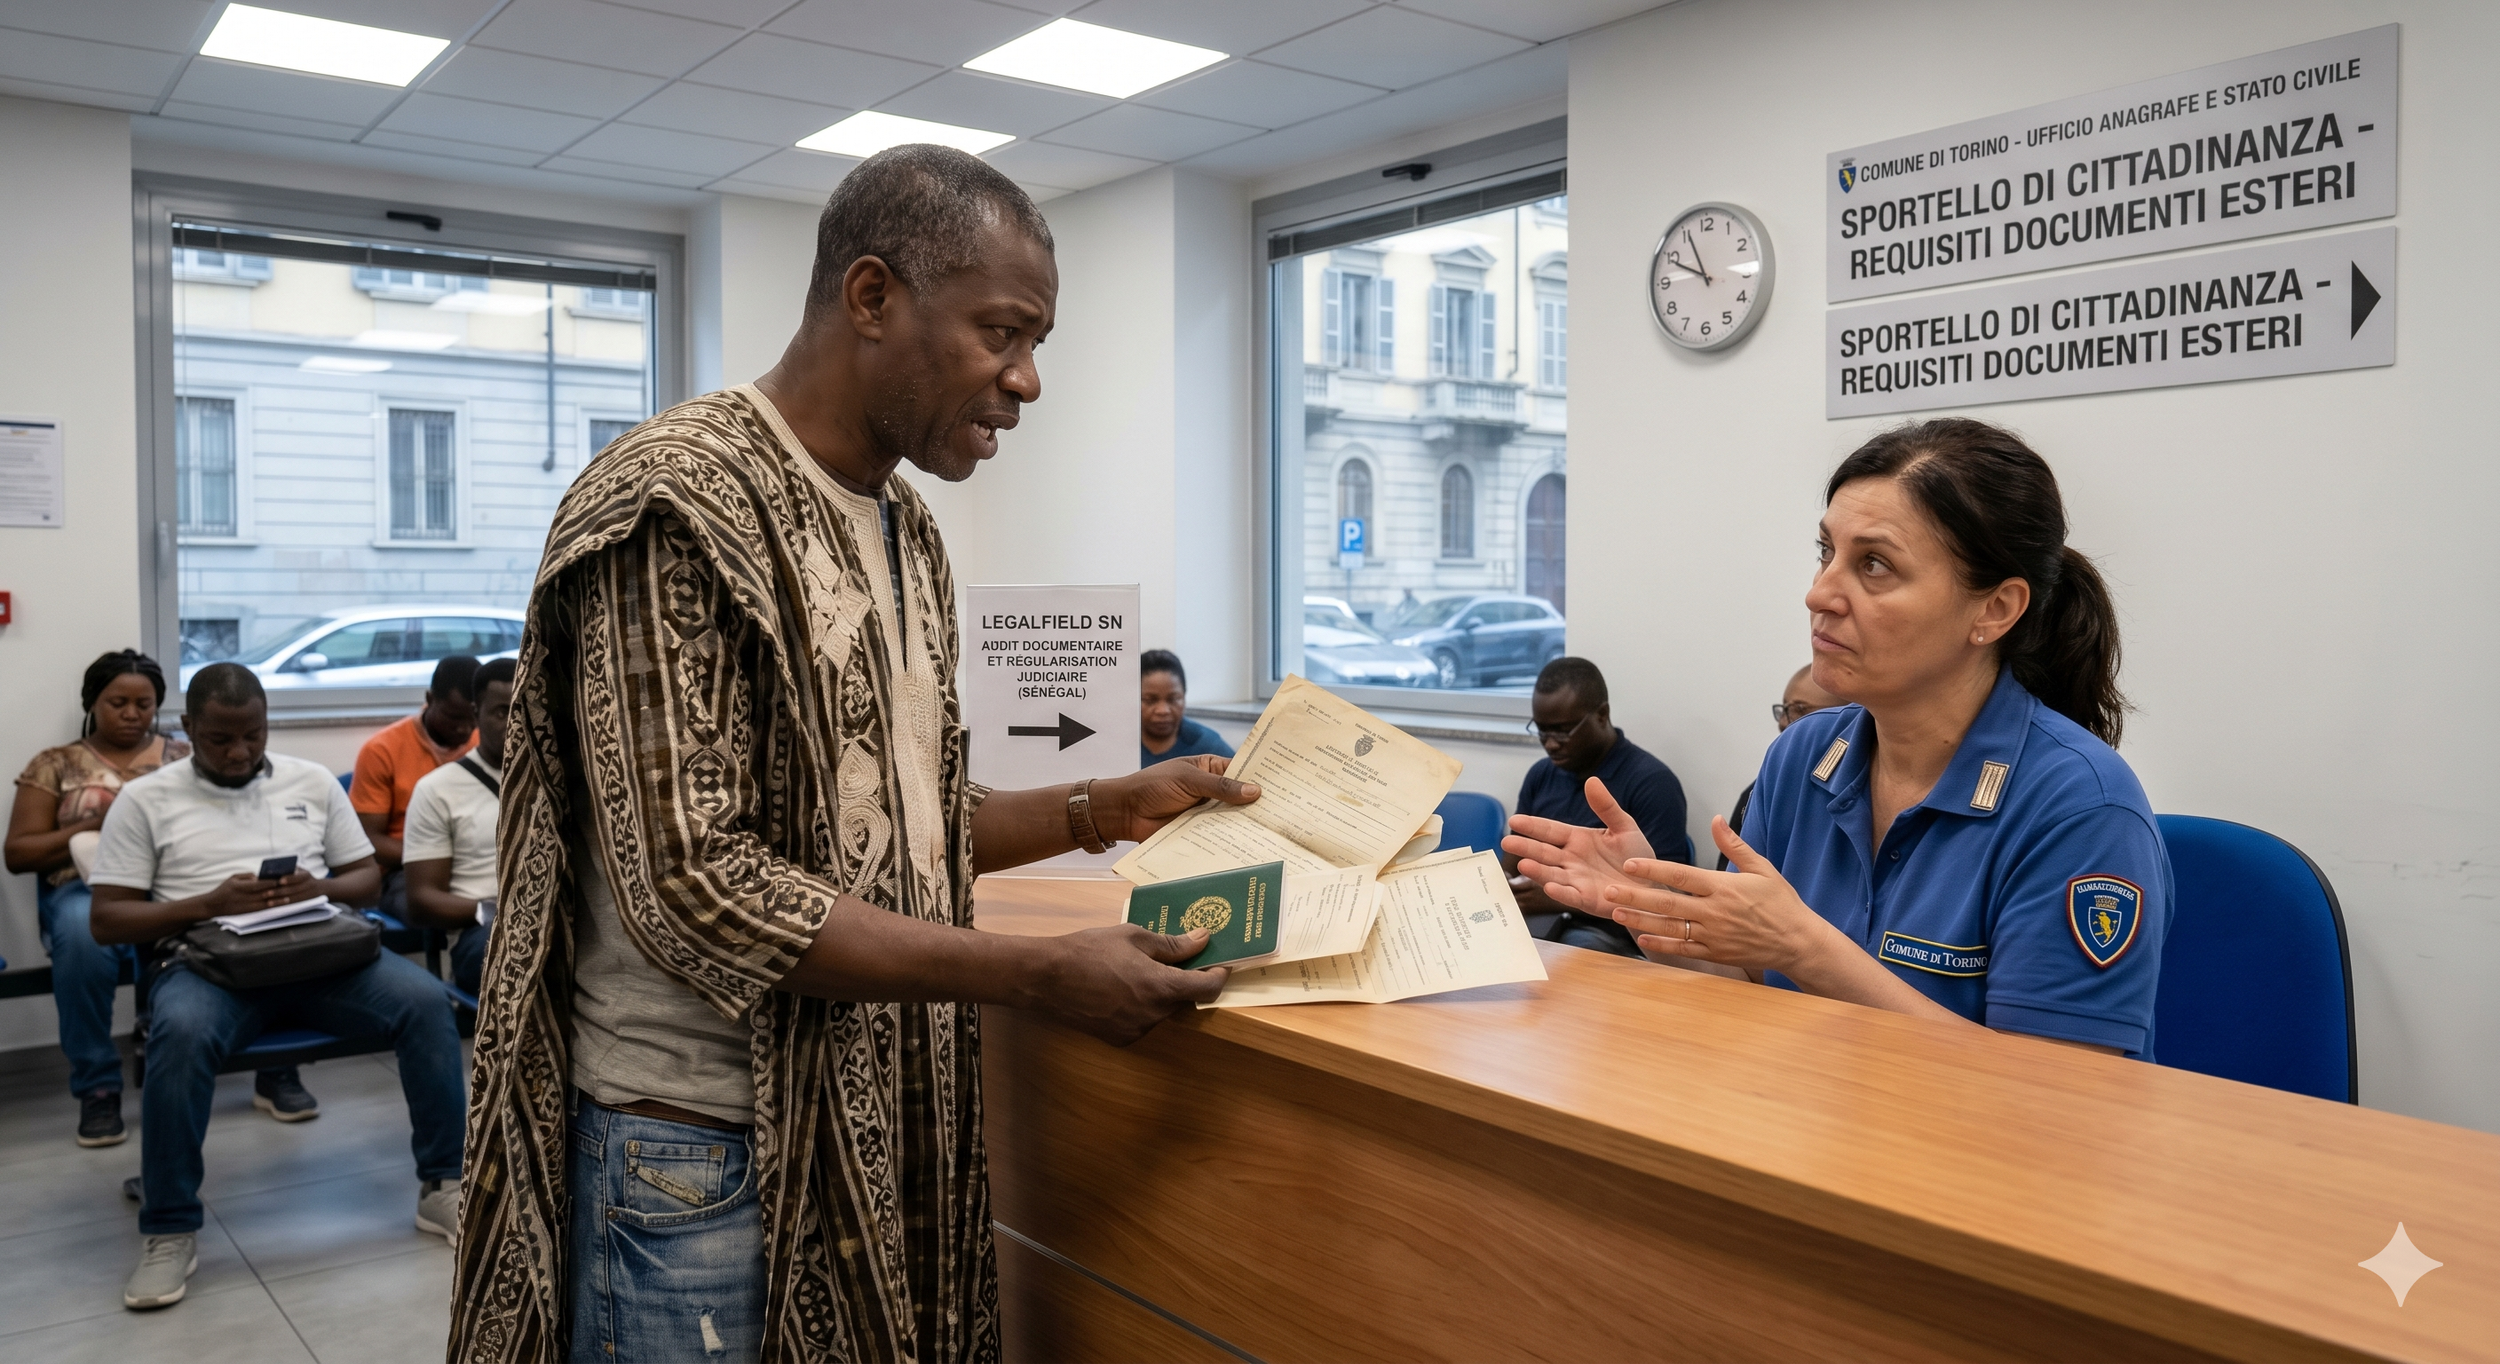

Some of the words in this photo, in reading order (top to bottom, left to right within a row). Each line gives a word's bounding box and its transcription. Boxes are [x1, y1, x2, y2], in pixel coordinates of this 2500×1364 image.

[1861, 154, 1924, 183] COMUNE
[1929, 149, 1944, 169] DI
[1950, 135, 2009, 163] TORINO
[2027, 116, 2093, 148] UFFICIO
[2099, 93, 2199, 133] ANAGRAFE
[2206, 89, 2217, 110] E
[2224, 75, 2286, 106] STATO
[2293, 57, 2361, 91] CIVILE
[1841, 178, 2011, 239] SPORTELLO
[2023, 168, 2054, 206] DI
[2067, 112, 2344, 197] CITTADINANZA
[2358, 123, 2374, 133] -
[1700, 217, 1714, 233] 12
[1851, 226, 1991, 280] REQUISITI
[2004, 188, 2205, 255] DOCUMENTI
[2220, 161, 2355, 219] ESTERI
[1737, 238, 1747, 252] 2
[1667, 250, 1680, 265] 10
[1661, 276, 1671, 290] 9
[1736, 290, 1747, 303] 4
[1667, 301, 1677, 315] 8
[1840, 309, 1999, 358] SPORTELLO
[2011, 303, 2039, 336] DI
[2051, 268, 2303, 331] CITTADINANZA
[2316, 280, 2331, 288] -
[1681, 317, 1690, 331] 7
[1722, 311, 1732, 325] 5
[1701, 321, 1711, 335] 6
[1841, 353, 1972, 396] REQUISITI
[1984, 329, 2167, 380] DOCUMENTI
[2181, 313, 2302, 359] ESTERI
[1344, 521, 1361, 550] P
[982, 615, 1092, 630] LEGALFIELD
[1098, 615, 1122, 630] SN
[1022, 640, 1123, 651] DOCUMENTAIRE
[987, 656, 1003, 667] ET
[1006, 654, 1117, 667] RÉGULARISATION
[1017, 671, 1087, 682] JUDICIAIRE
